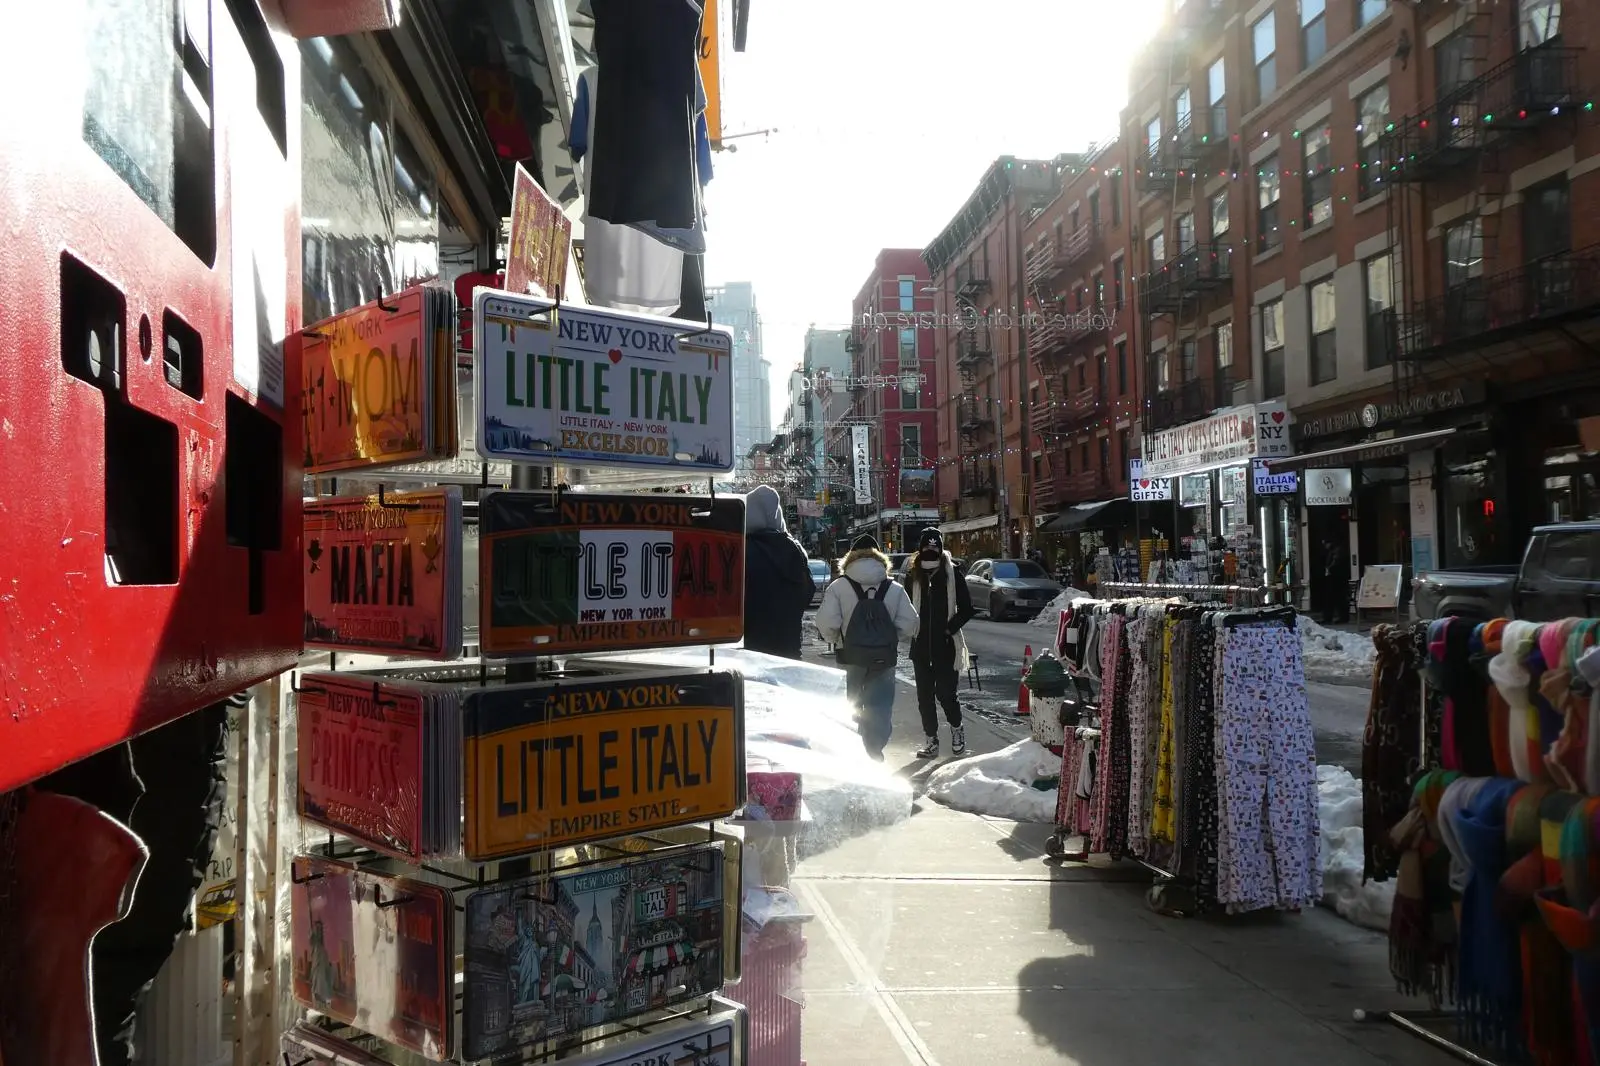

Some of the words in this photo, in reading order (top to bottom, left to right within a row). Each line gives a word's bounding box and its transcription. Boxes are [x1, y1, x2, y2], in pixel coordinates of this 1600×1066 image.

[325, 329, 348, 349] NEW
[350, 317, 383, 345] YORK
[557, 318, 613, 345] NEW
[616, 326, 677, 354] YORK
[338, 337, 419, 429] MOM
[505, 350, 611, 416] LITTLE
[629, 366, 713, 425] ITALY
[560, 416, 588, 428] LITTLE
[589, 417, 614, 430] ITALY
[624, 421, 644, 433] NEW
[646, 423, 668, 434] YORK
[1167, 428, 1185, 459] ITALY
[1187, 422, 1207, 453] GIFTS
[1209, 414, 1240, 448] CENTER
[1260, 426, 1284, 439] NY
[560, 429, 670, 457] EXCELSIOR
[1150, 478, 1170, 489] NY
[1255, 474, 1297, 486] ITALIAN
[1258, 485, 1291, 493] GIFTS
[1133, 491, 1165, 500] GIFTS
[1307, 496, 1337, 505] COCKTAIL
[337, 510, 366, 531] NEW
[371, 507, 408, 530] YORK
[559, 501, 627, 525] NEW
[630, 503, 693, 525] YORK
[330, 544, 415, 607] MAFIA
[496, 541, 629, 601] LITTLE
[640, 541, 739, 600] ITALY
[581, 609, 606, 621] NEW
[611, 608, 633, 620] YOR
[639, 607, 668, 619] YORK
[556, 623, 630, 643] EMPIRE
[637, 620, 691, 638] STATE
[328, 692, 352, 714] NEW
[354, 694, 387, 723] YORK
[550, 689, 613, 717] NEW
[615, 683, 682, 708] YORK
[310, 726, 400, 807] PRINCESS
[496, 729, 620, 818] LITTLE
[631, 718, 719, 796] ITALY
[550, 809, 622, 837] EMPIRE
[628, 799, 682, 825] STATE
[575, 876, 597, 891] NEW
[600, 870, 627, 886] YORK
[640, 888, 671, 903] LITTLE
[640, 899, 670, 917] ITALY
